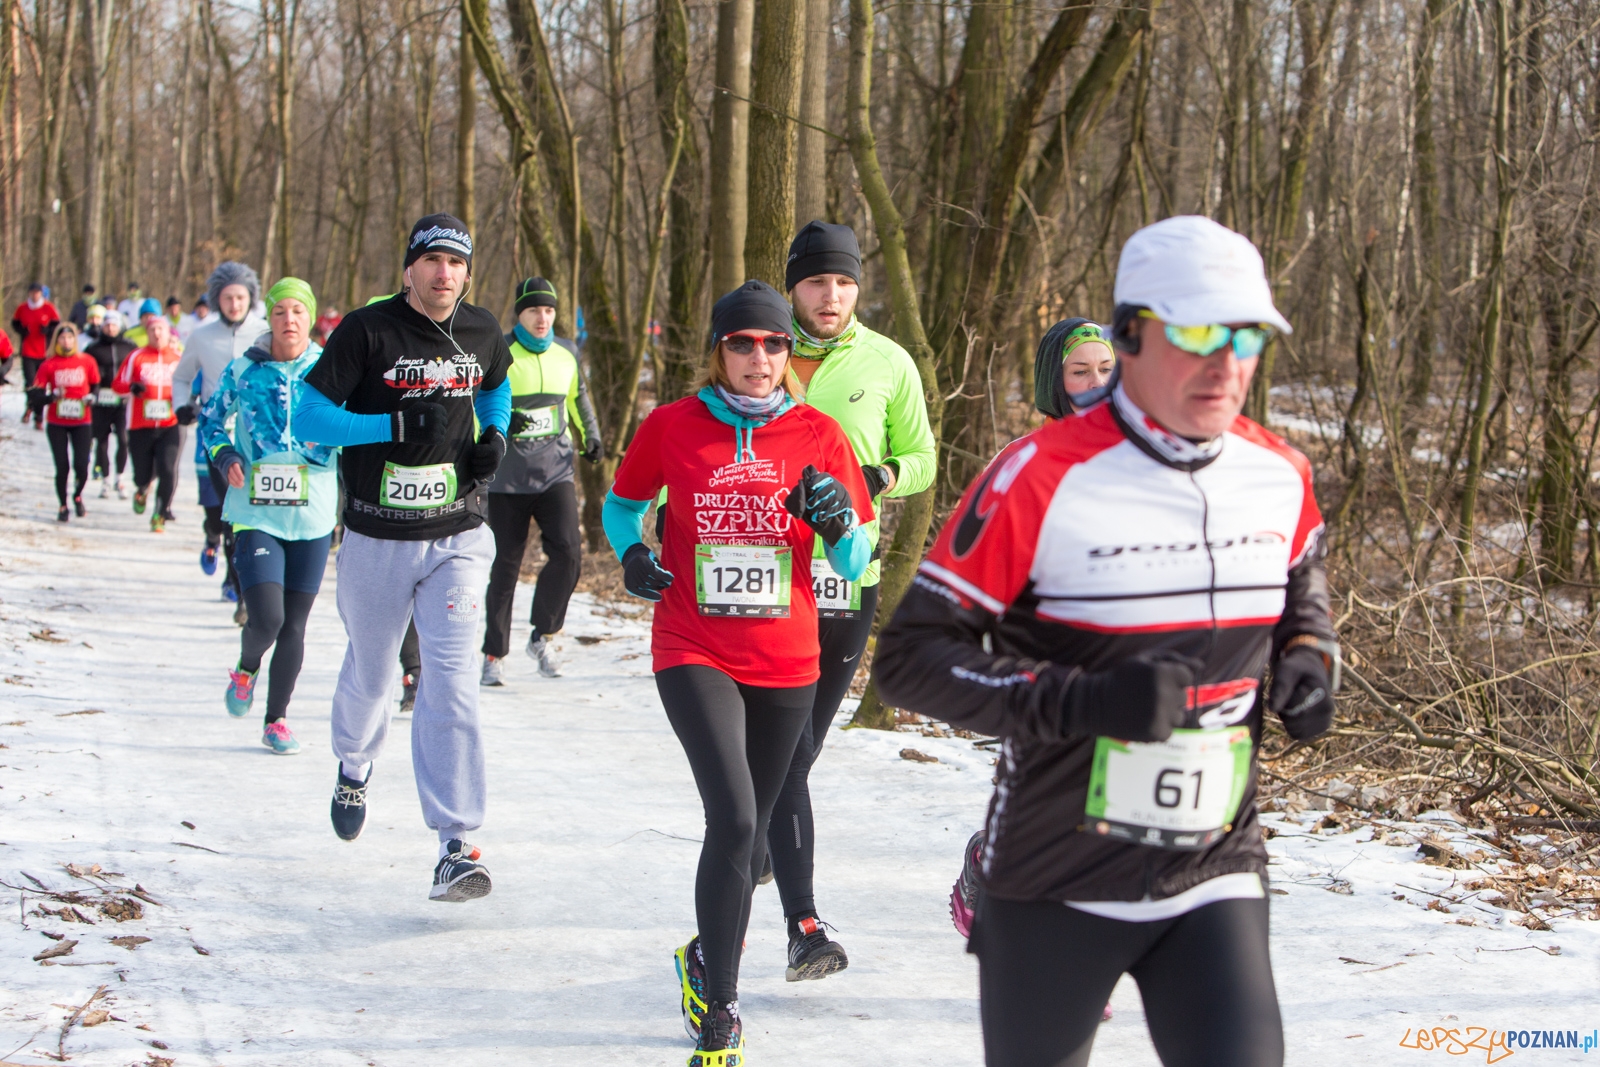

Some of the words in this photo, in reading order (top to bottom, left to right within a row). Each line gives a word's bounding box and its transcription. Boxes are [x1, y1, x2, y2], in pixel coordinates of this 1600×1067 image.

[261, 476, 298, 492] 904
[389, 481, 447, 501] 2049
[693, 490, 778, 511] DRUŻYNA
[695, 509, 794, 534] SZPIKU
[712, 566, 775, 594] 1281
[732, 595, 757, 604] IWONA
[1154, 768, 1204, 809] 61
